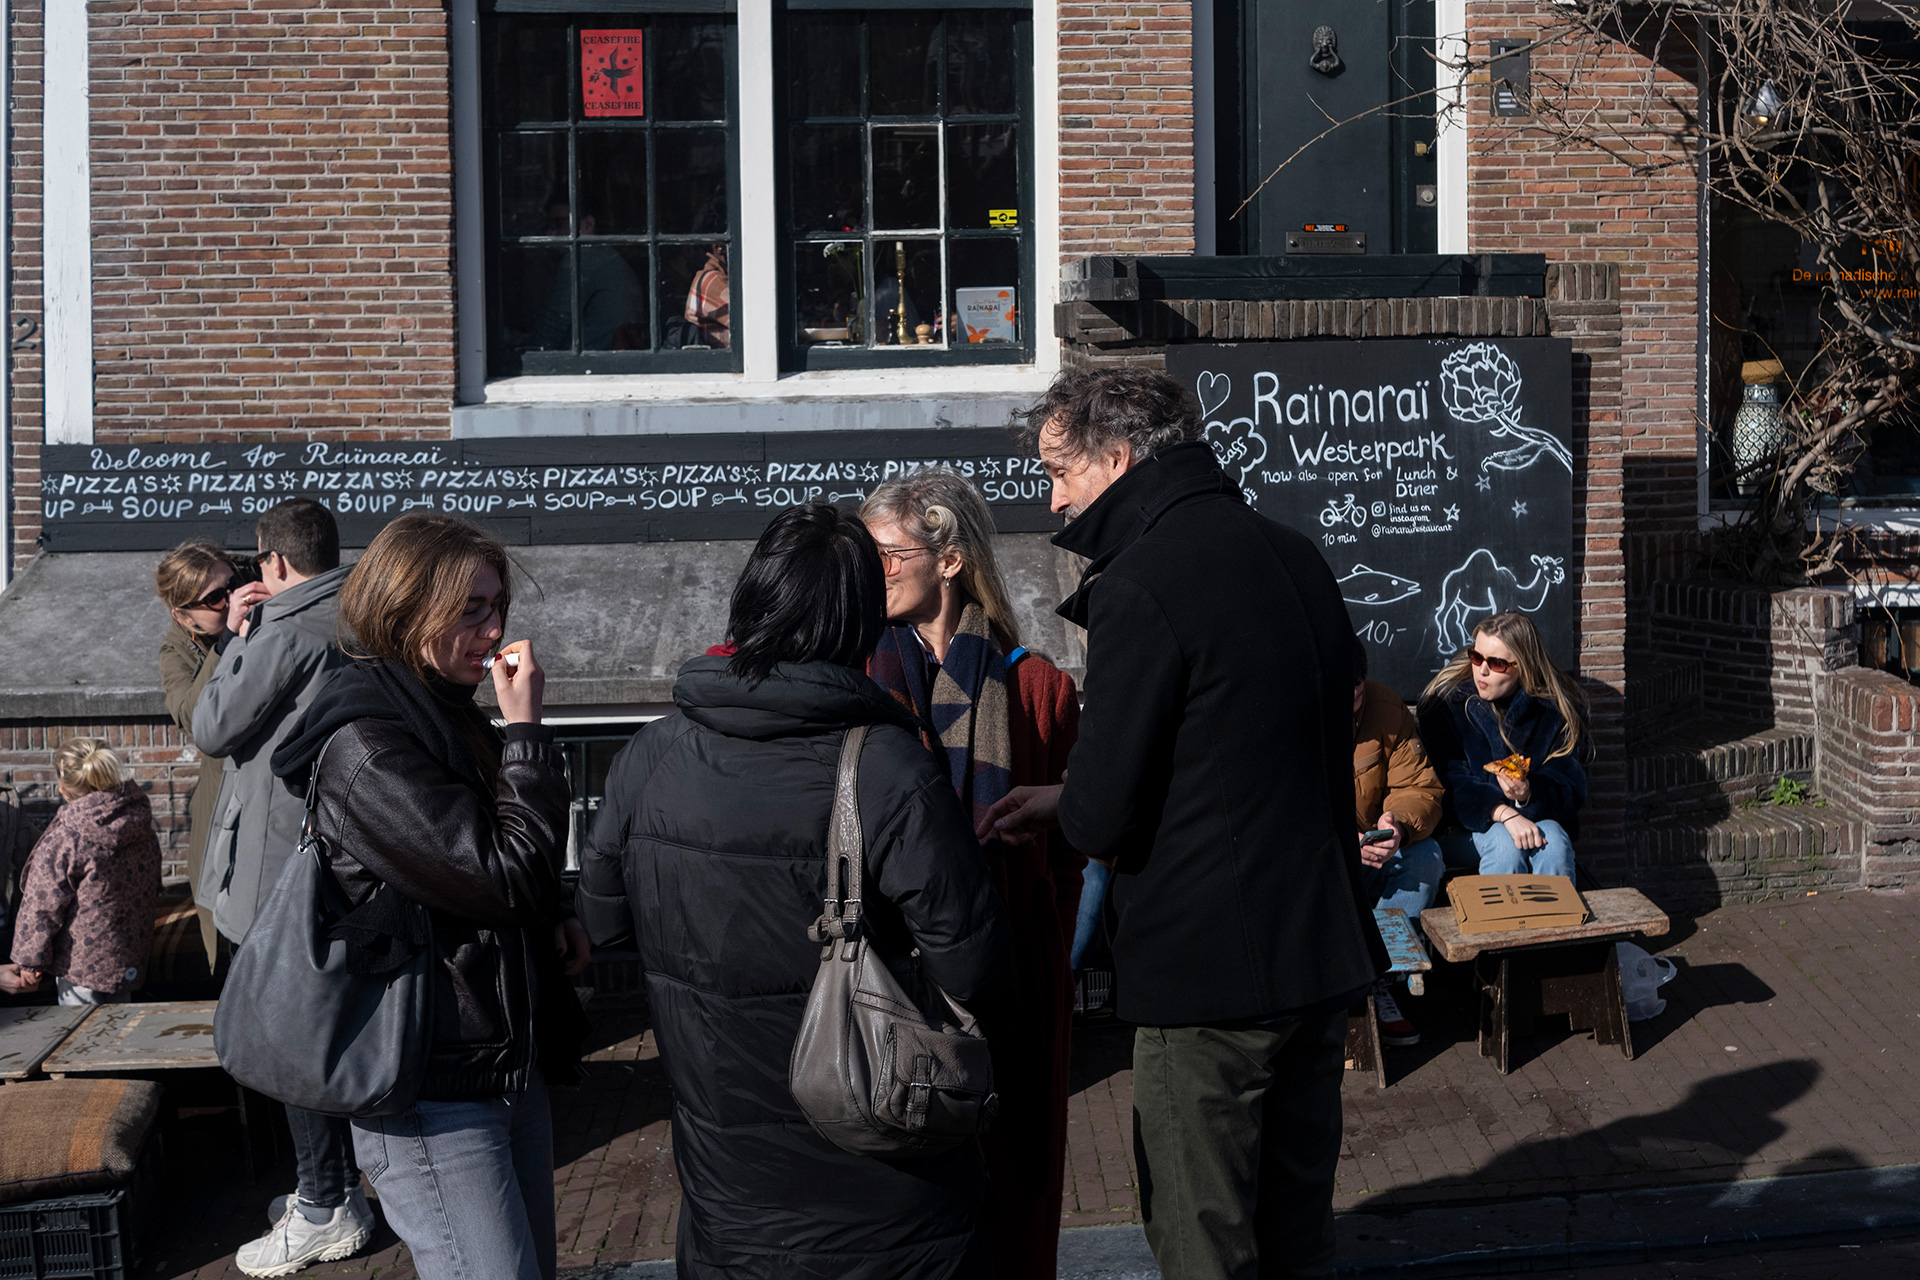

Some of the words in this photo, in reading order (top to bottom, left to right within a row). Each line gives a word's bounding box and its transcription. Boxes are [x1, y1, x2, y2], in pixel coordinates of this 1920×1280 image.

[582, 35, 641, 45] CEASEFIRE
[584, 101, 642, 110] CEASEFIRE
[1792, 267, 1812, 281] De
[1253, 371, 1430, 427] Raïnaraï
[90, 447, 228, 471] Welcome
[241, 444, 286, 468] to
[1216, 436, 1248, 471] taff
[1289, 430, 1456, 470] Westerpark
[59, 473, 158, 495] PIZZA'S
[187, 472, 275, 493] PIZZA'S
[302, 470, 396, 490] PIZZA'S
[420, 469, 515, 489] PIZZA'S
[543, 466, 639, 488] PIZZA'S
[661, 464, 741, 485] PIZZA'S
[767, 460, 856, 484] PIZZA'S
[1006, 457, 1045, 476] PIZ
[1261, 470, 1293, 484] now
[1298, 469, 1318, 482] also
[1327, 471, 1359, 487] open
[1363, 467, 1383, 482] for
[1395, 461, 1436, 482] Lunch
[1446, 466, 1459, 481] &
[44, 499, 76, 519] UP
[121, 496, 194, 519] SOUP
[336, 491, 397, 513] SOUP
[441, 492, 503, 513] SOUP
[544, 490, 606, 511] SOUP
[639, 486, 708, 510] SOUP
[754, 486, 823, 506] SOUP
[983, 479, 1051, 502] SOUP
[1395, 483, 1439, 498] Diner
[1389, 503, 1408, 515] find
[1390, 515, 1431, 527] instagram
[1322, 533, 1335, 547] 10
[1337, 533, 1358, 544] min
[1356, 619, 1407, 647] 10,-
